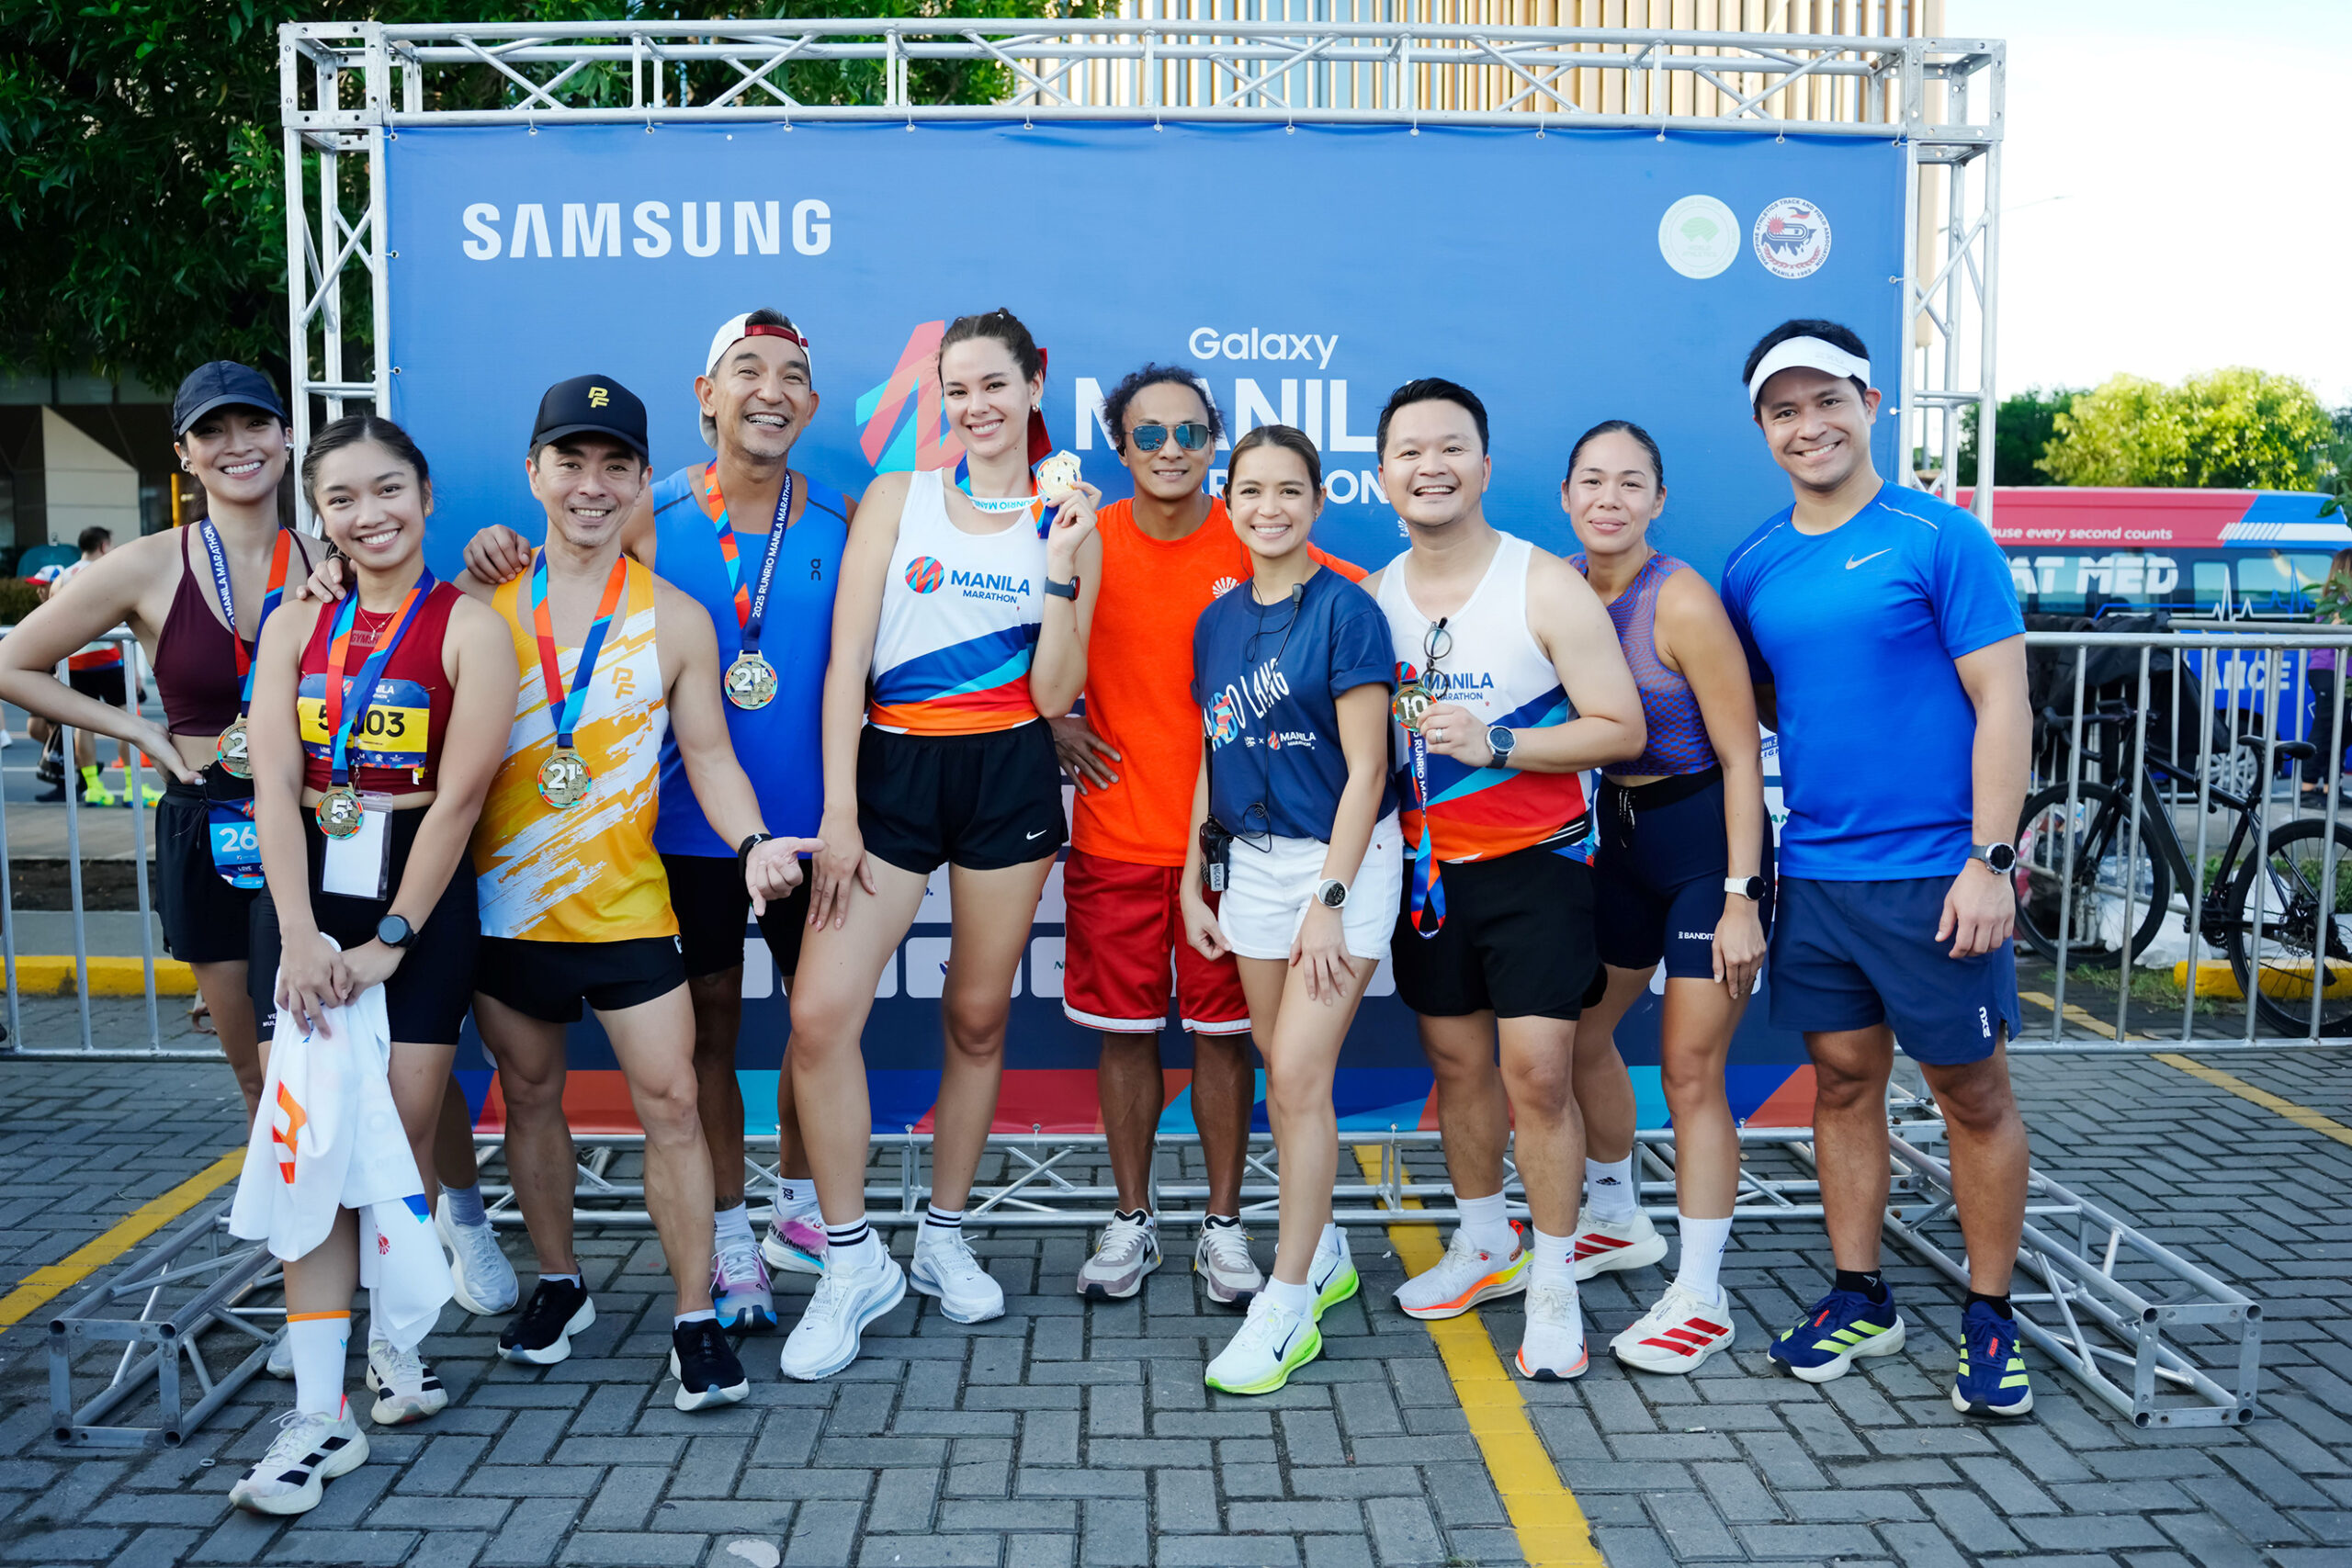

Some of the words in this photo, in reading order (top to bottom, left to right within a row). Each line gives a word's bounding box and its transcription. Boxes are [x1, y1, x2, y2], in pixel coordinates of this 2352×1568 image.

[1802, 201, 1815, 210] AND
[463, 198, 831, 260] SAMSUNG
[1189, 327, 1339, 369] Galaxy
[777, 474, 791, 523] MARATHON
[203, 525, 226, 577] MARATHON
[768, 523, 785, 558] MANILA
[2026, 527, 2067, 542] every
[2069, 526, 2122, 540] second
[2124, 529, 2173, 540] counts
[758, 557, 775, 595] RUNRIO
[951, 570, 1031, 596] MANILA
[2075, 557, 2179, 594] MED
[219, 577, 234, 617] MANILA
[752, 595, 765, 618] 2025
[963, 589, 1018, 604] MARATHON
[1239, 658, 1290, 719] LANG
[1424, 672, 1495, 691] MANILA
[1414, 739, 1426, 780] RUNRIO
[1213, 864, 1222, 888] NICOLE
